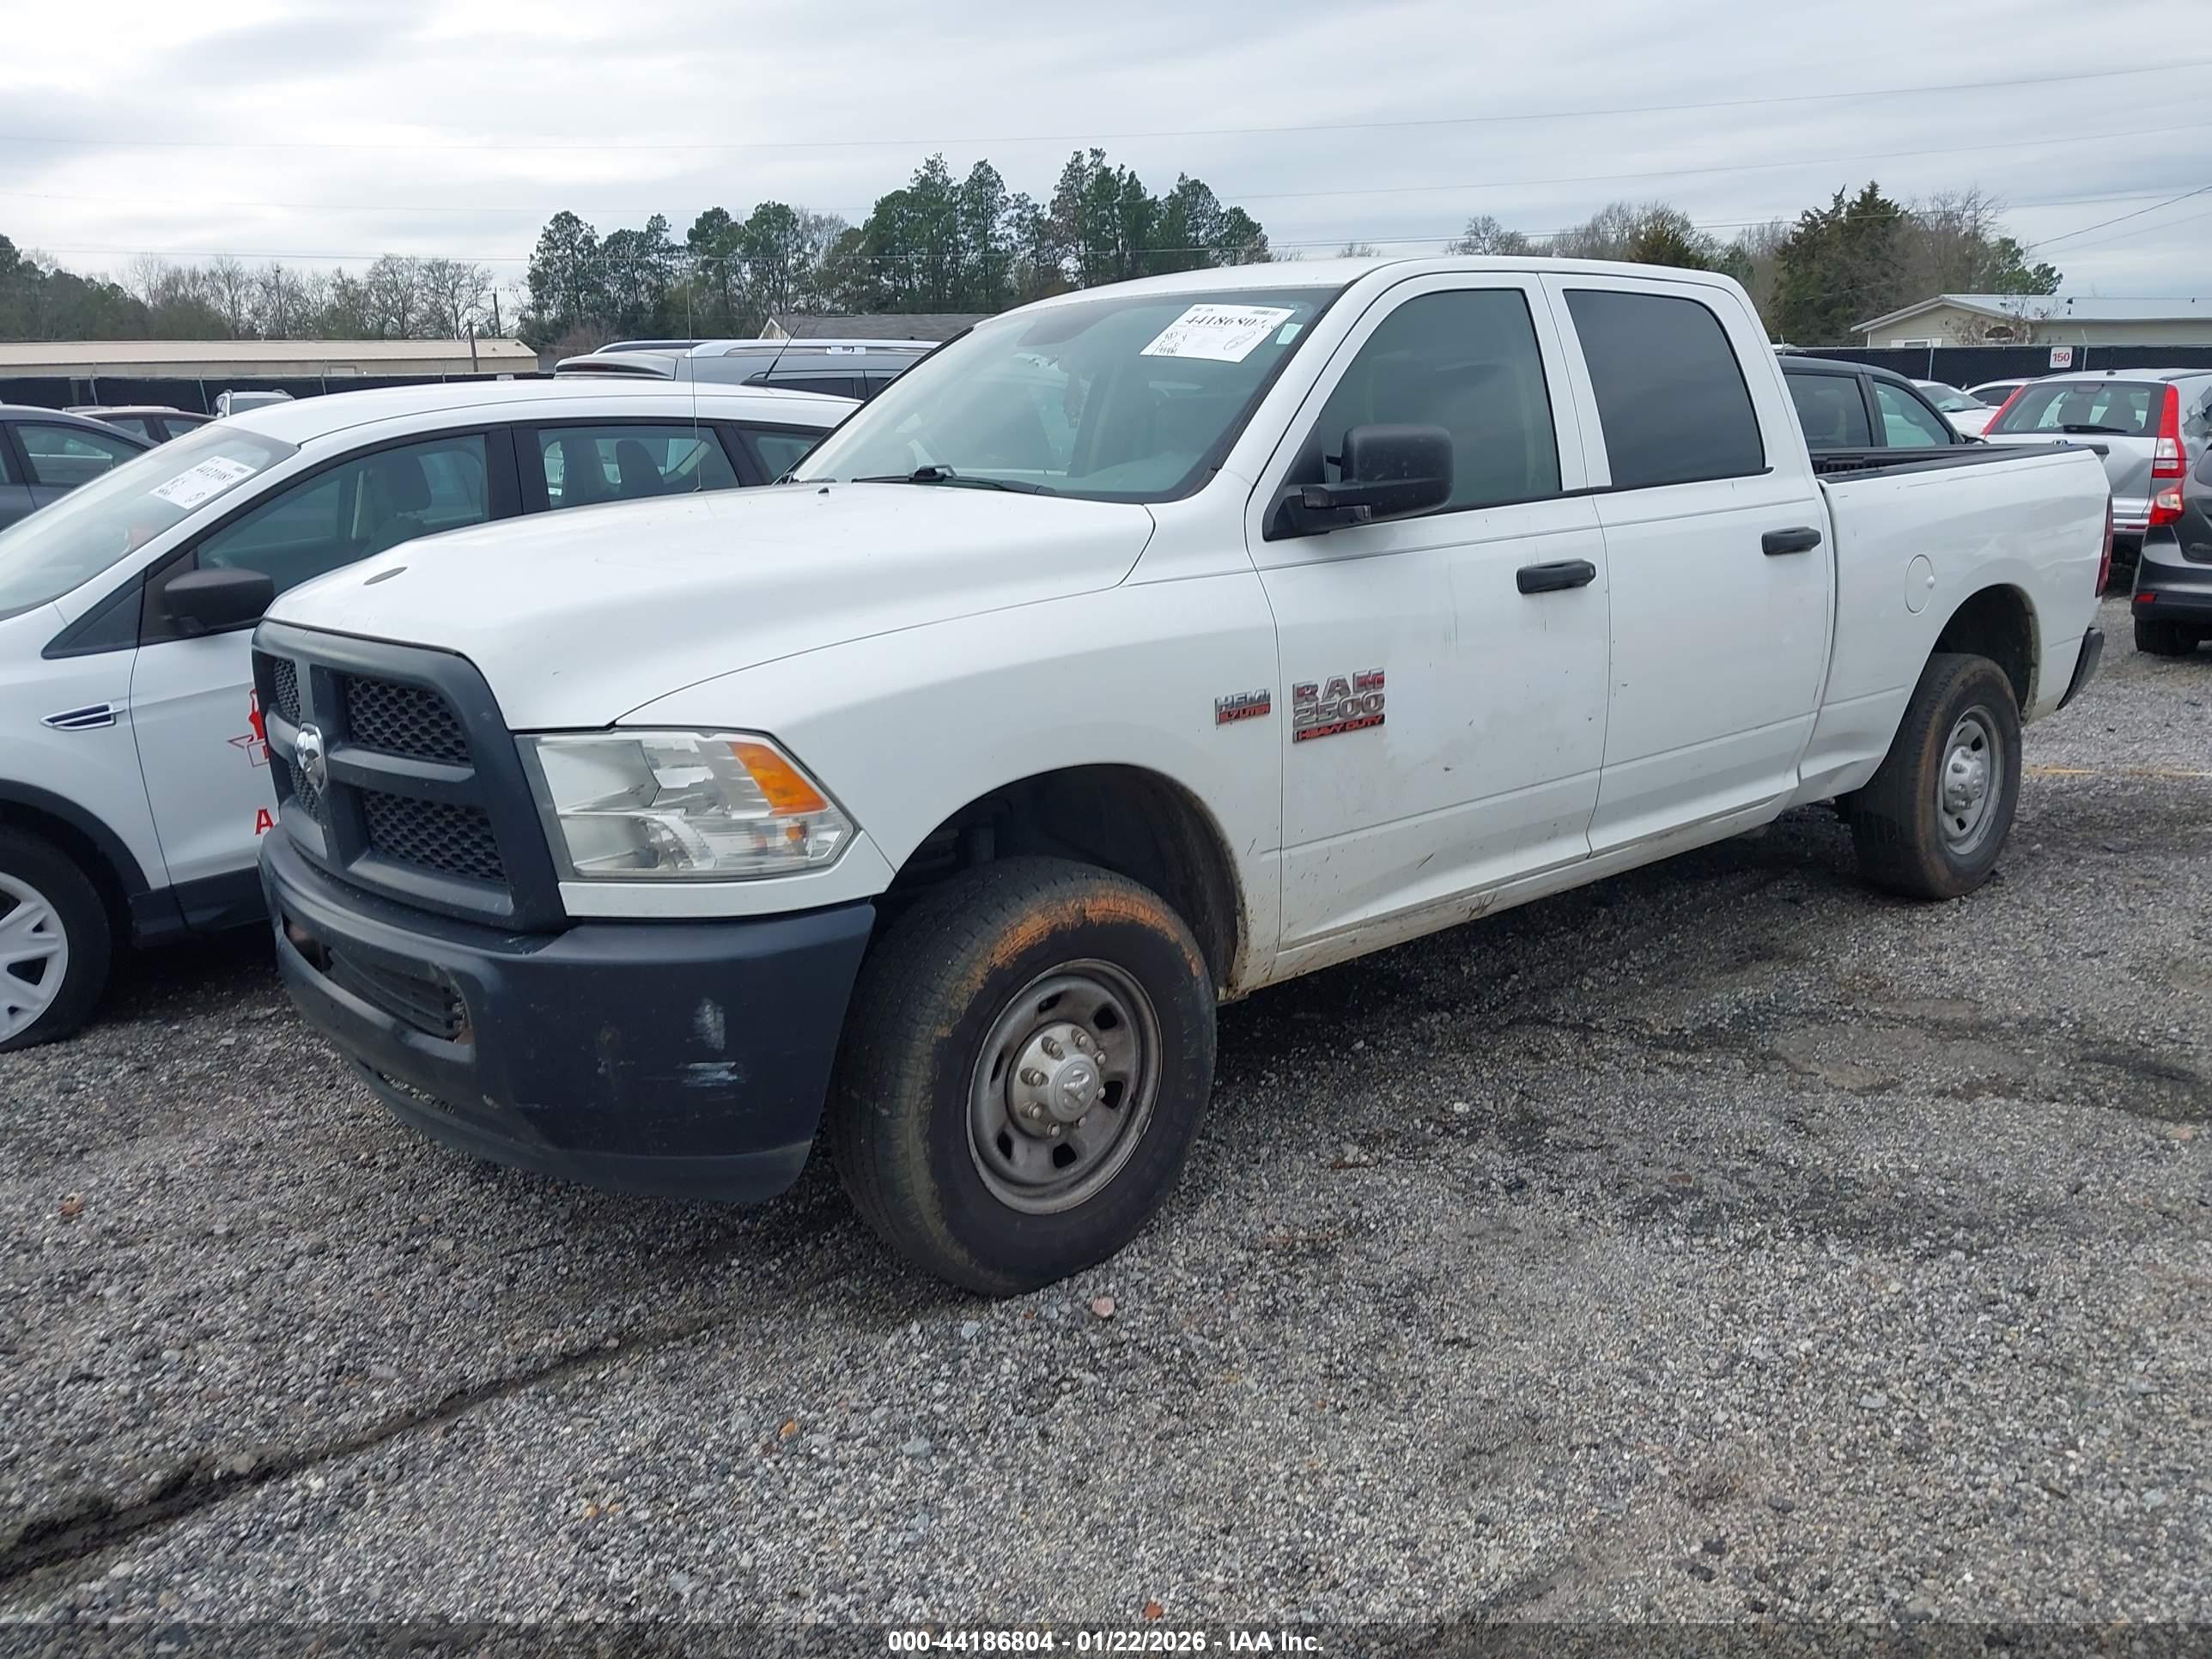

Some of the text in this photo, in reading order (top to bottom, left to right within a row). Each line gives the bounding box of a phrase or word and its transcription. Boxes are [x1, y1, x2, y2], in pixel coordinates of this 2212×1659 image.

[2052, 352, 2070, 362] 150
[1293, 667, 1385, 705] RAM
[1214, 689, 1271, 710] HEMI
[1239, 703, 1270, 718] LITER
[1293, 691, 1386, 728] 2500
[1297, 714, 1383, 740] HEAVY DUTY
